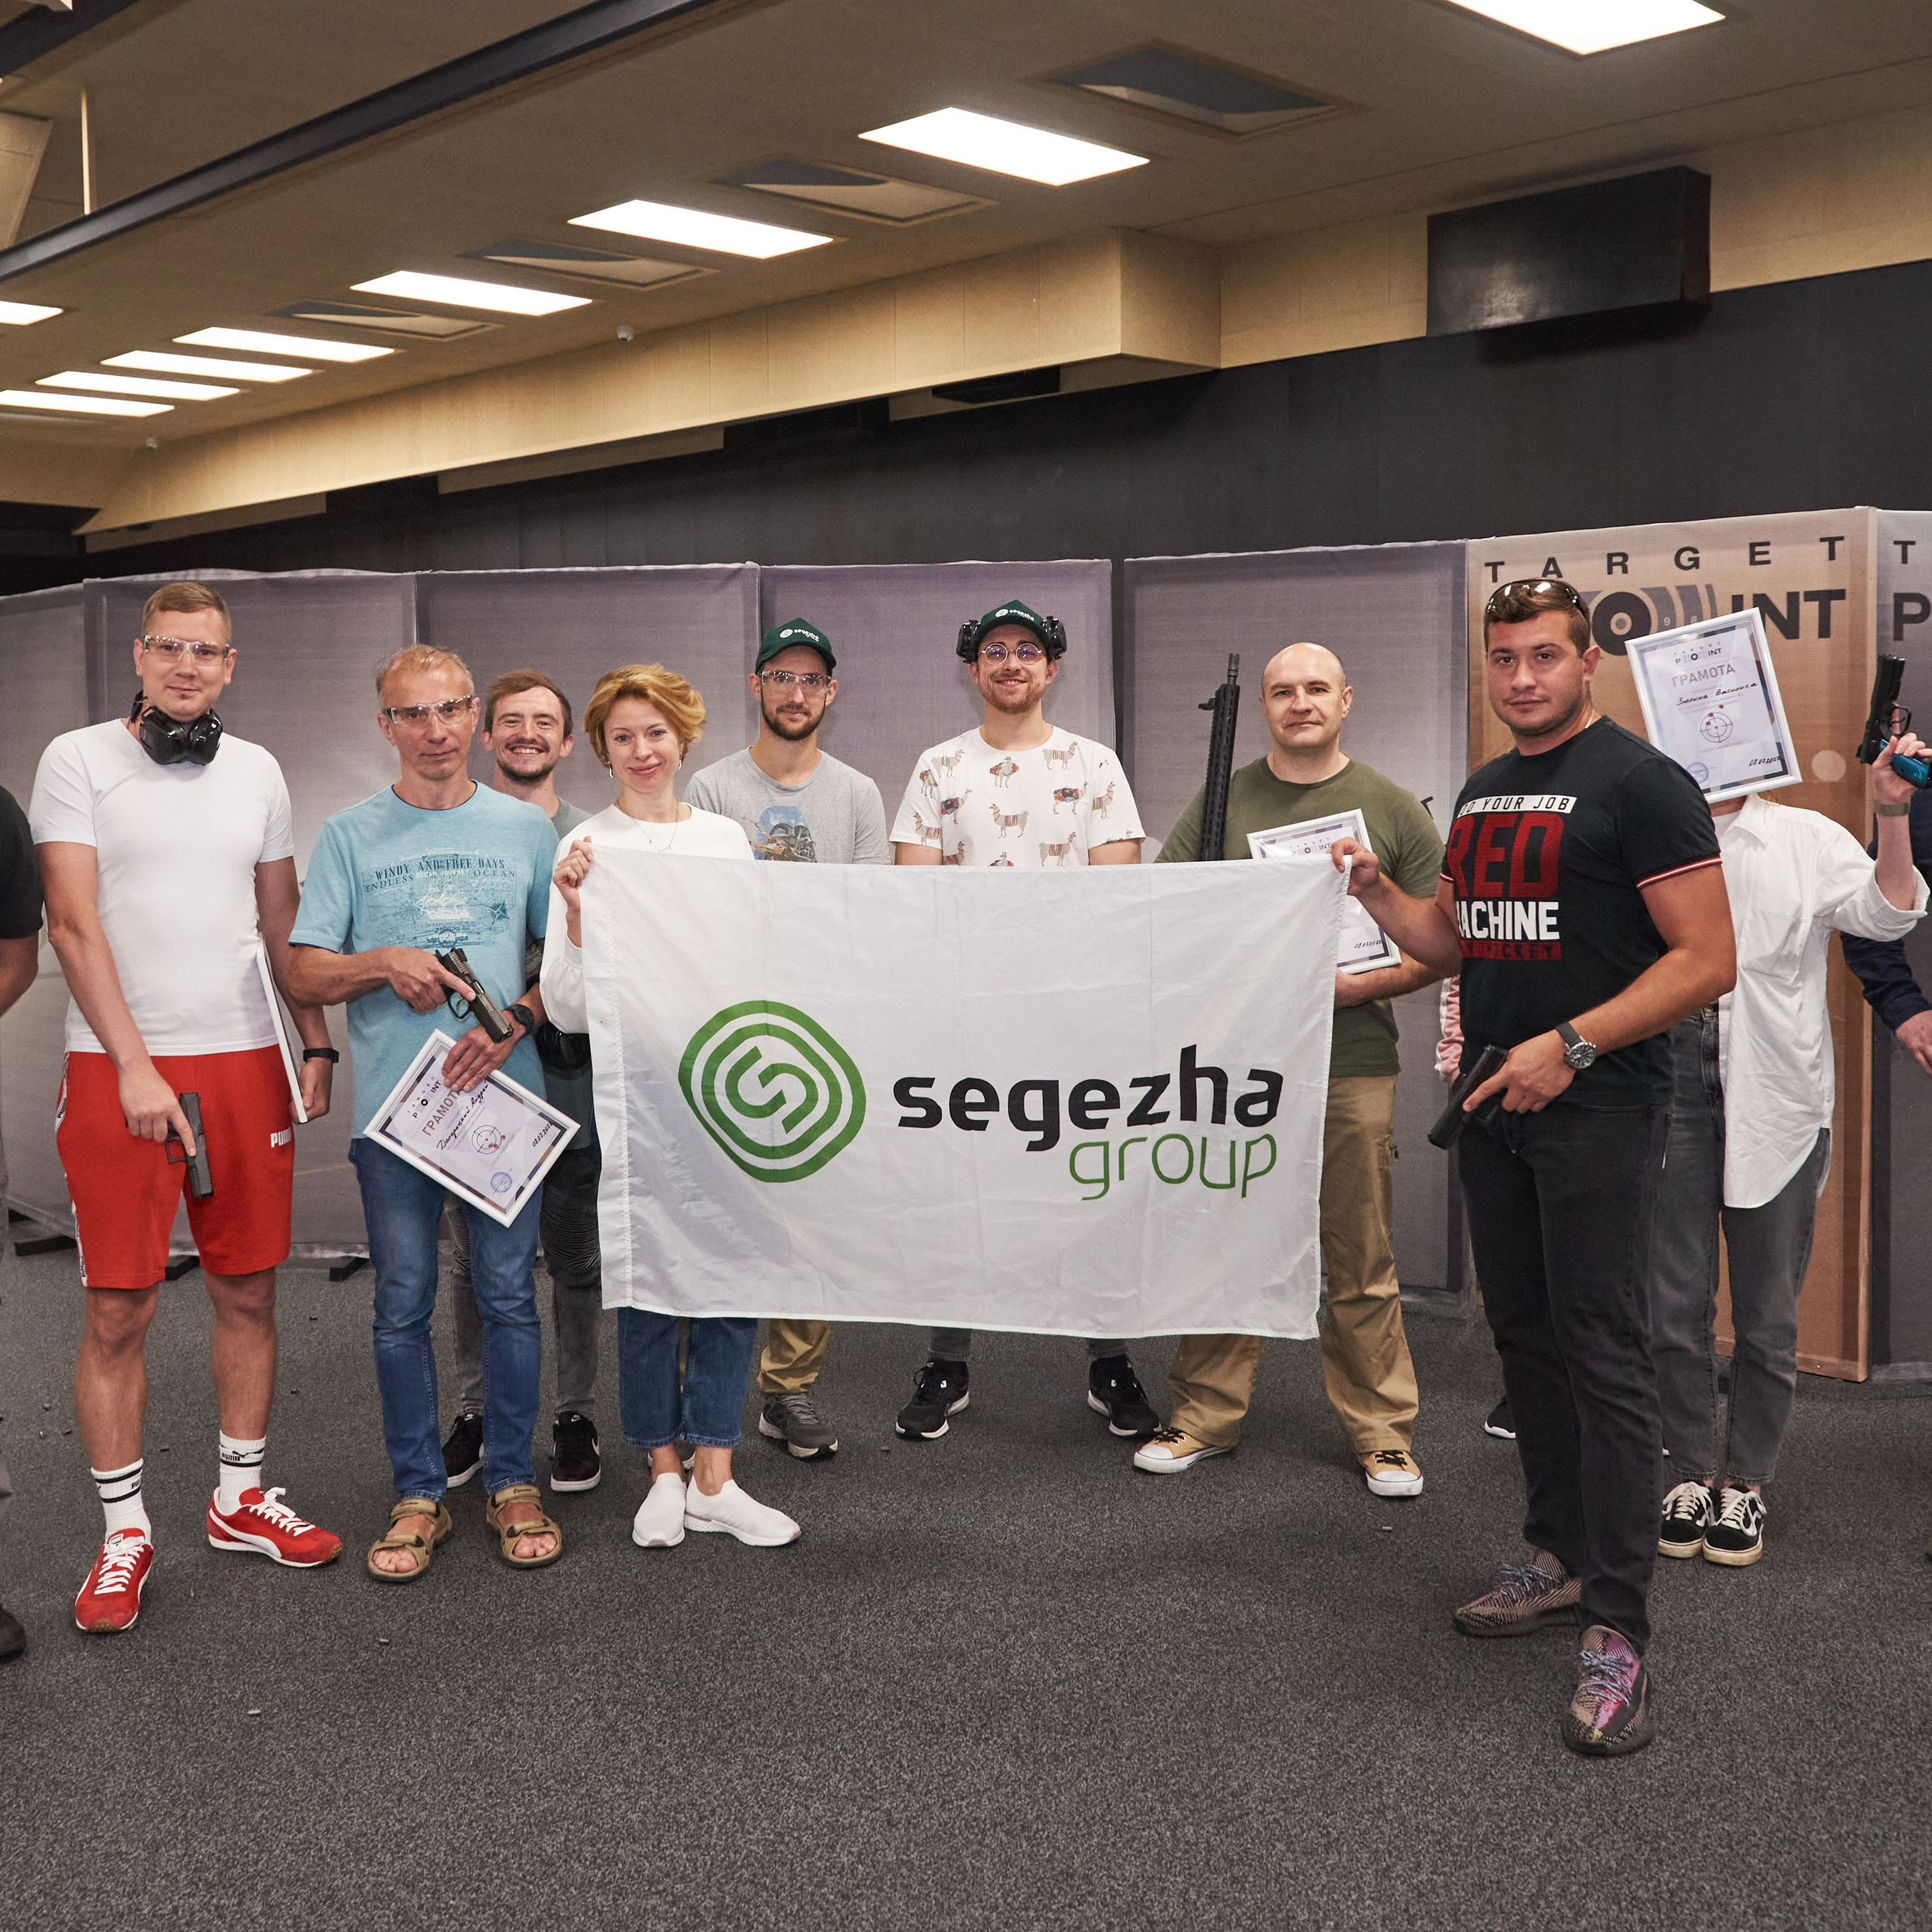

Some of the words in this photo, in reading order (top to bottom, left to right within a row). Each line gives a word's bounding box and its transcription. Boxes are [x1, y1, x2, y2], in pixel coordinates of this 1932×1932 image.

[1485, 537, 1844, 583] TARGET
[1675, 648, 1721, 664] POINT
[1672, 663, 1735, 688] ГРАМОТА
[1482, 797, 1524, 811] YOUR
[1533, 796, 1570, 811] JOB
[375, 863, 409, 880] WINDY
[418, 860, 440, 872] AND
[446, 858, 472, 870] FREE
[478, 858, 505, 869] DAYS
[1447, 812, 1564, 899] RED
[365, 875, 414, 893] ENDLESS
[473, 869, 515, 878] OCEAN
[412, 1080, 441, 1119] POINT
[893, 1044, 1283, 1152] segezha
[1069, 1133, 1277, 1201] group
